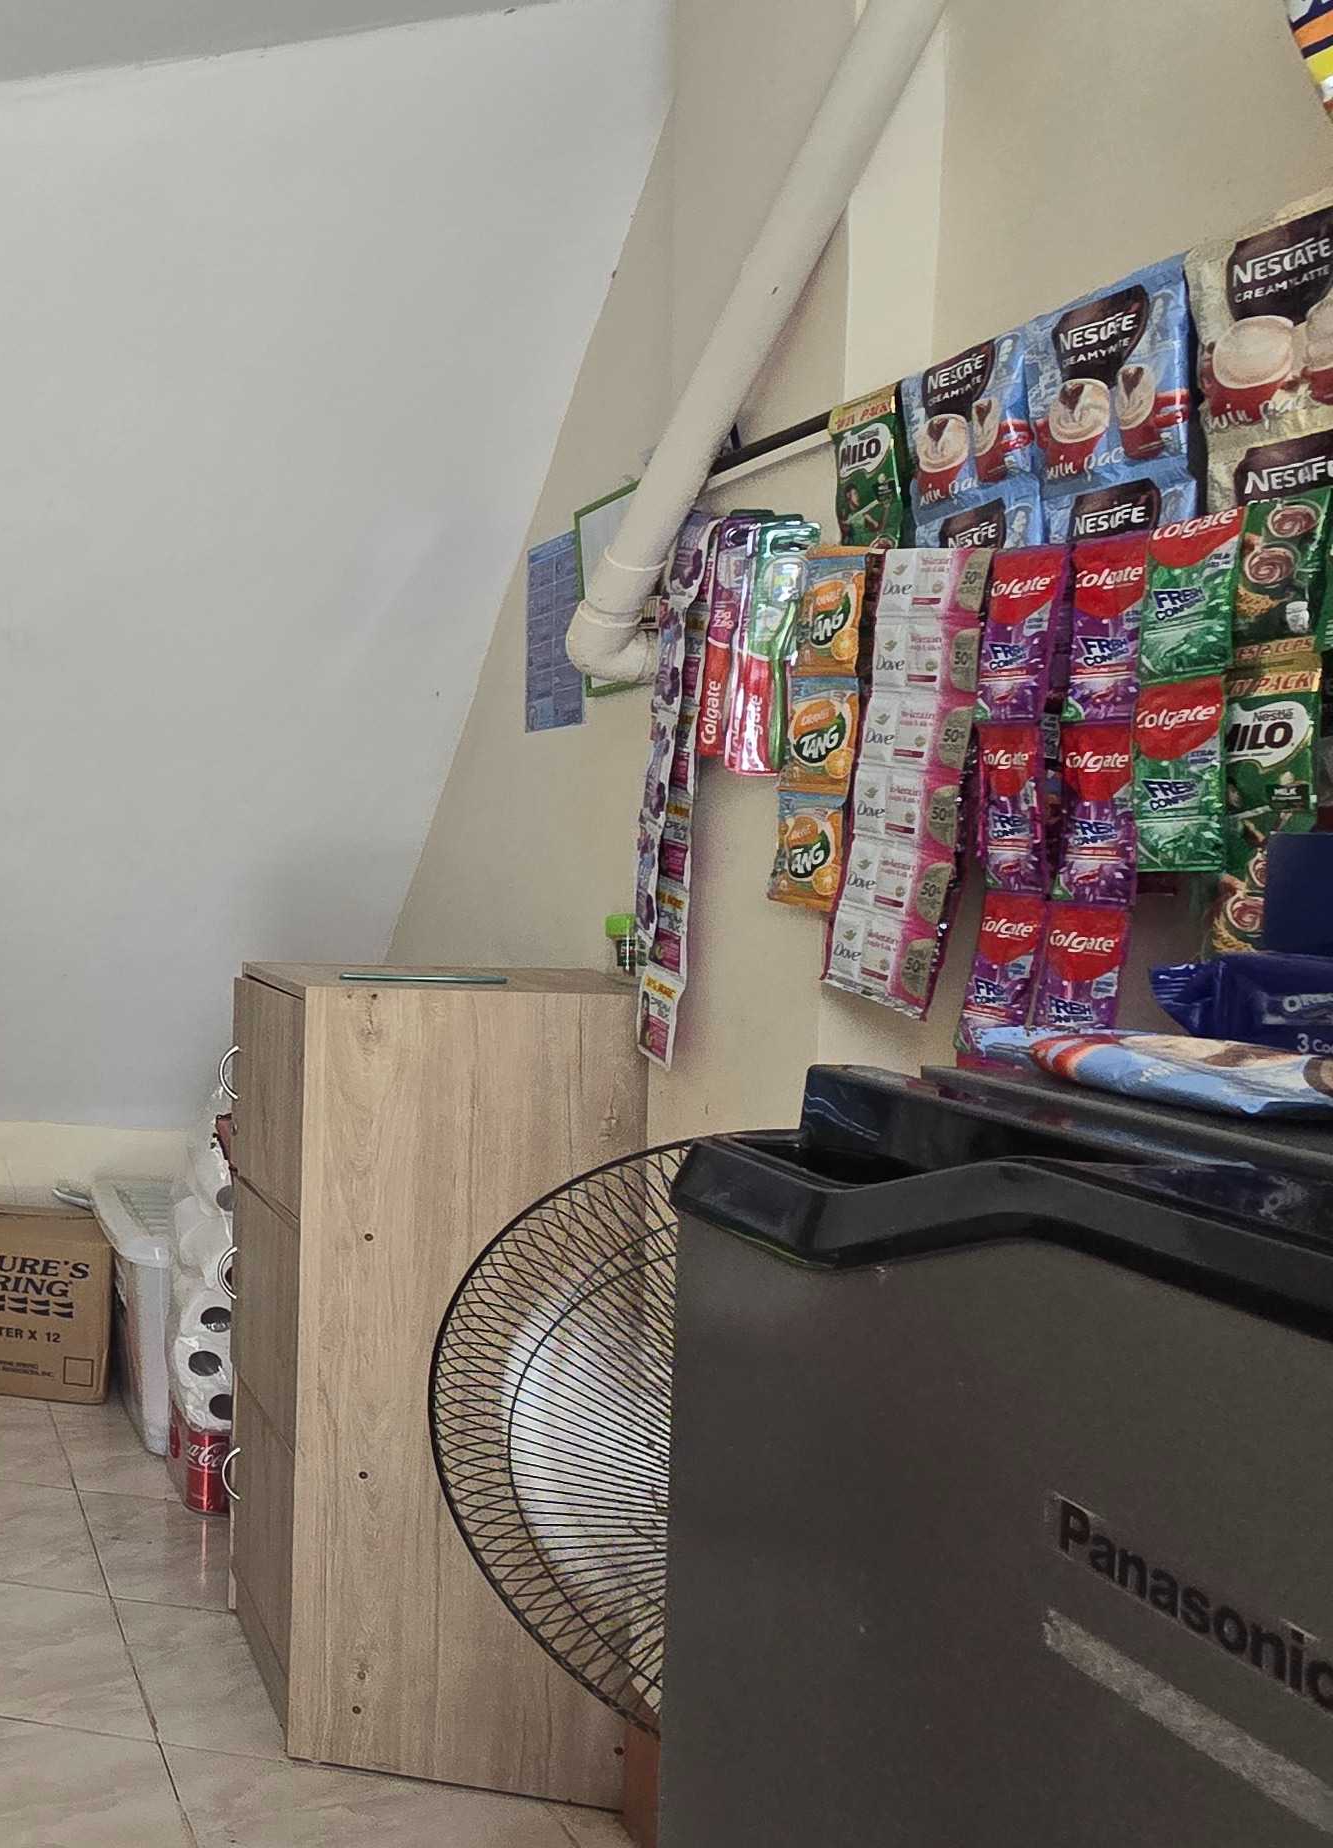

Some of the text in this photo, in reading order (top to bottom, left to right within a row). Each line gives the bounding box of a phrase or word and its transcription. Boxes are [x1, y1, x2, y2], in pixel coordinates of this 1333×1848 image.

[991, 574, 1051, 599] Colgate
[1076, 565, 1143, 590] Colgate
[875, 655, 905, 671] Dove
[700, 680, 723, 745] Colgate
[1135, 704, 1218, 730] Colgate
[800, 725, 839, 759] TANG
[864, 728, 895, 745] Dove
[856, 801, 886, 818] Dove
[847, 873, 877, 890] Dove
[834, 942, 862, 960] Dove
[1050, 929, 1115, 953] Colgate
[1297, 1033, 1309, 1053] 3
[28, 1330, 38, 1341] X
[45, 1332, 61, 1343] 12
[1059, 1502, 1333, 1713] Panasonic
